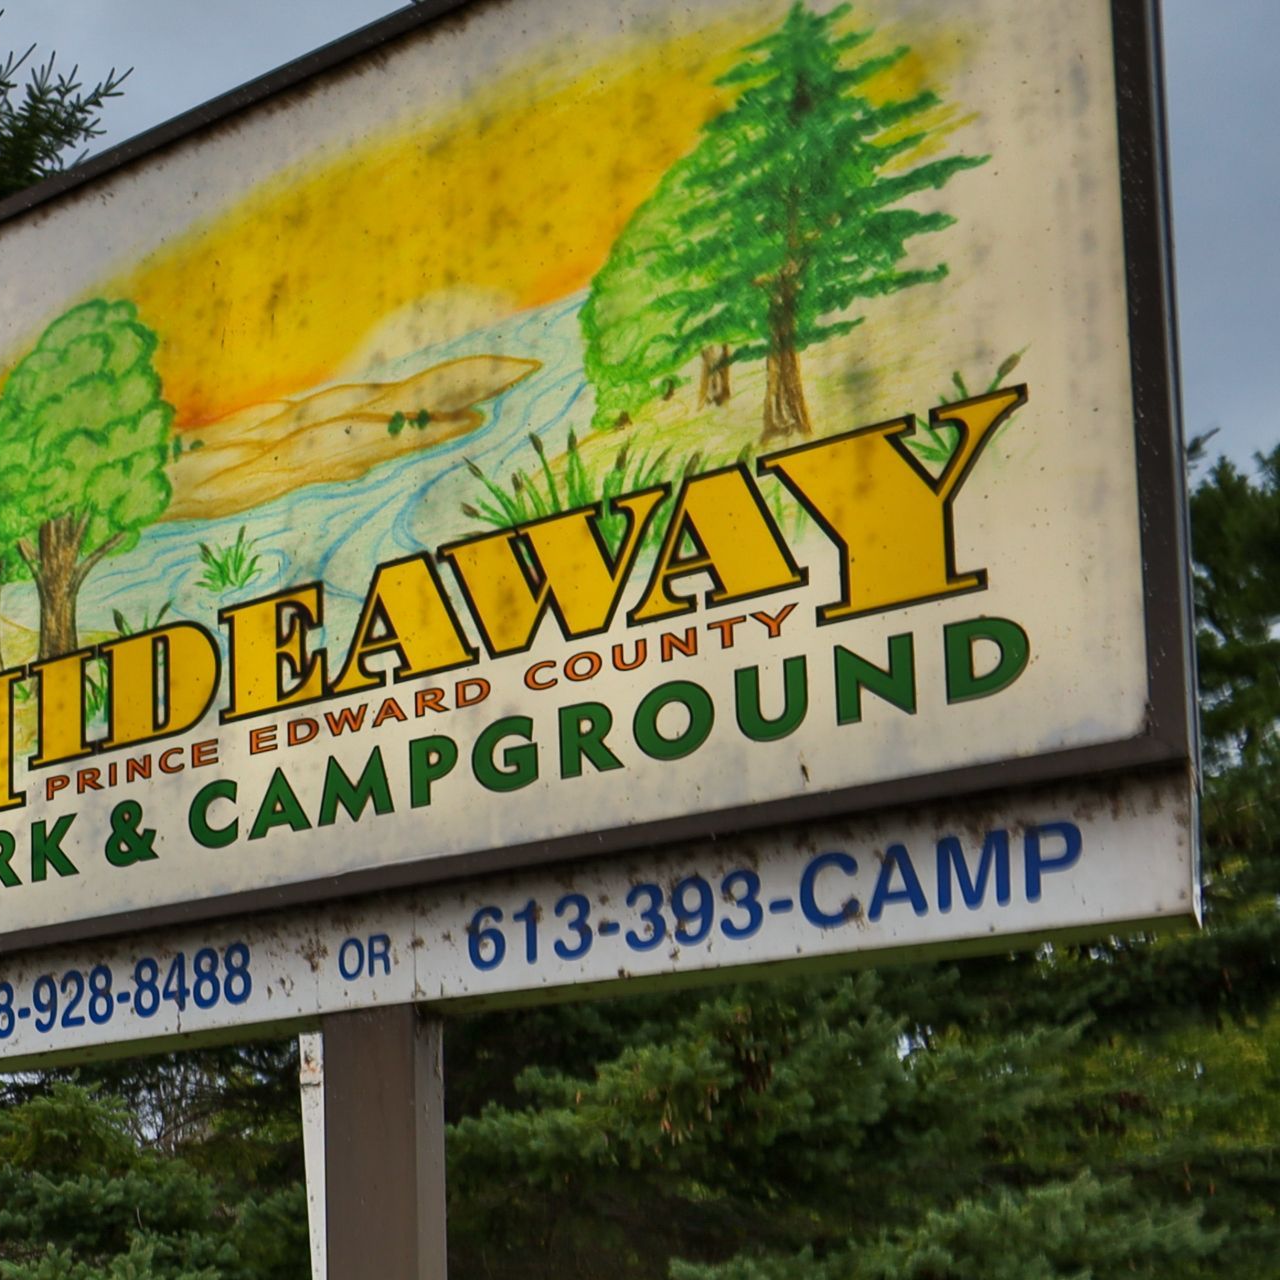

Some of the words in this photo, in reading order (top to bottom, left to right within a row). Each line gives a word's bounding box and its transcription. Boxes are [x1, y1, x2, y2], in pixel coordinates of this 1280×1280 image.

[44, 738, 220, 801] PRINCE
[248, 677, 492, 756] EDWARD
[522, 602, 800, 692] COUNTY
[103, 799, 160, 868] &
[187, 615, 1032, 850] CAMPGROUND
[337, 932, 393, 982] OR
[466, 819, 1084, 973] 613-393-CAMP
